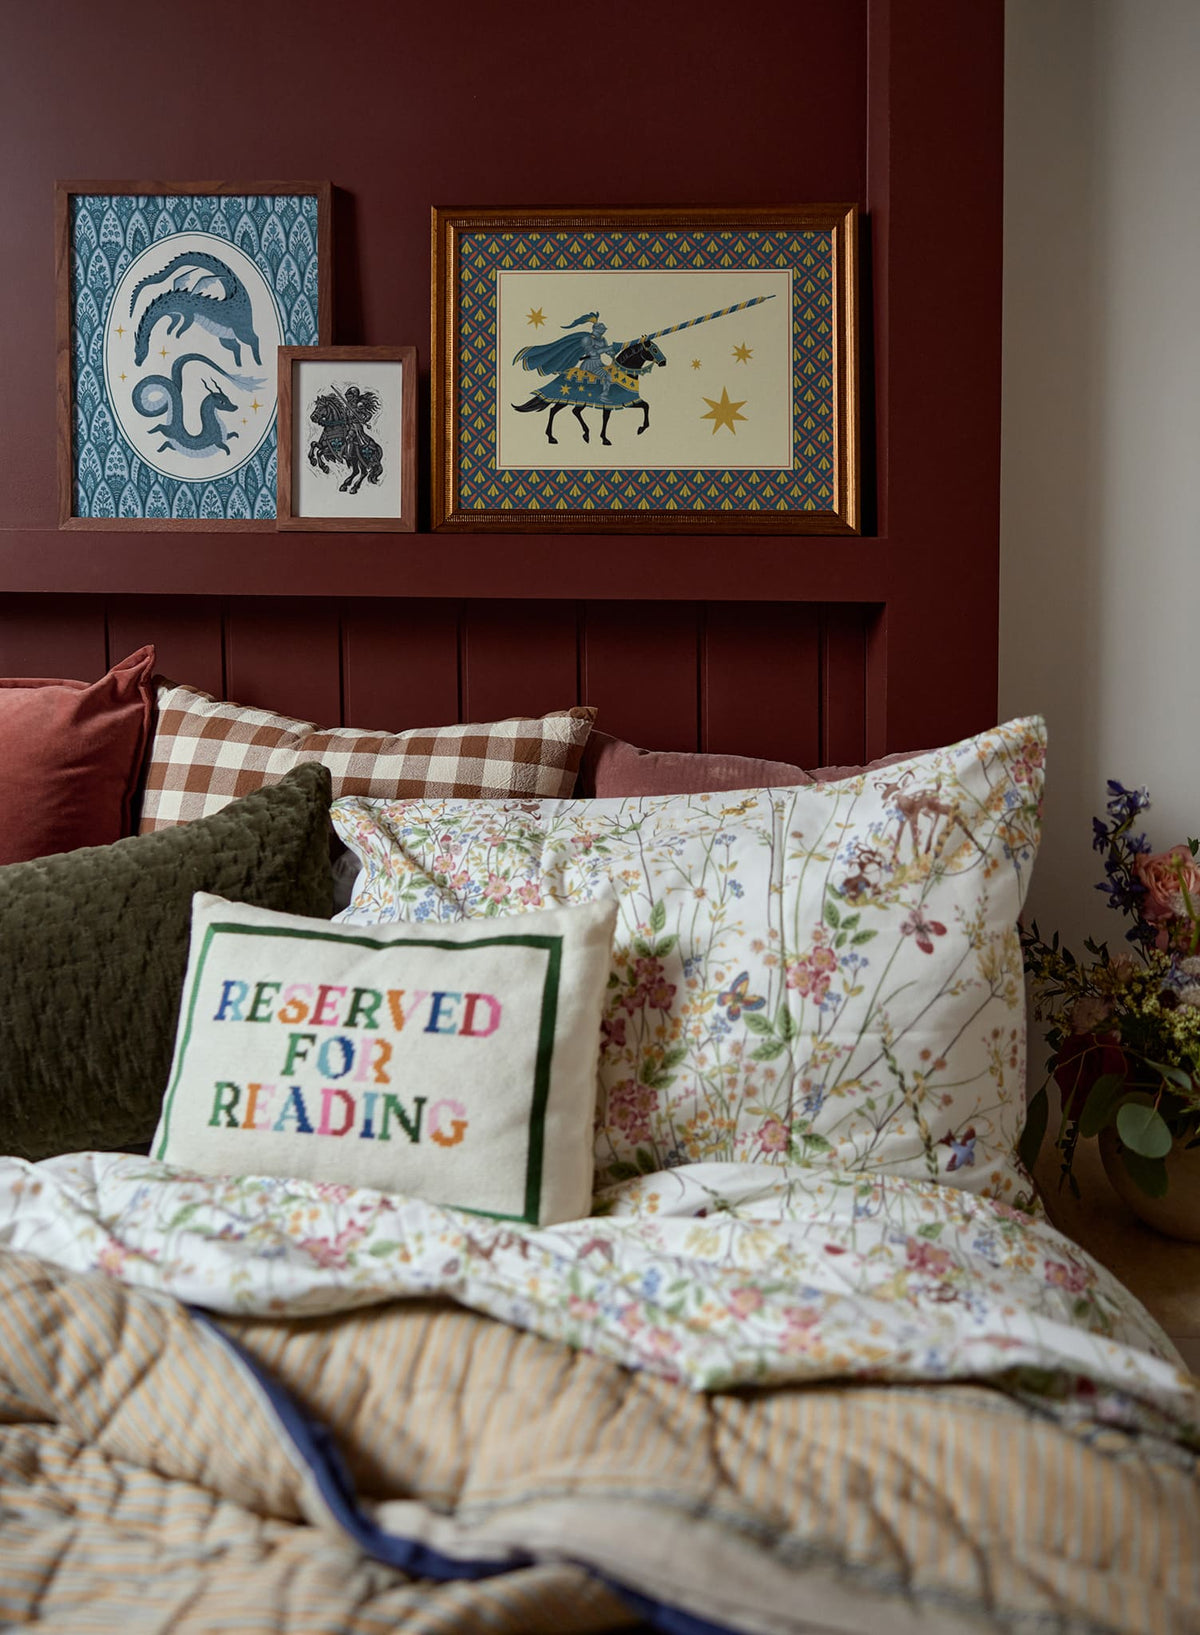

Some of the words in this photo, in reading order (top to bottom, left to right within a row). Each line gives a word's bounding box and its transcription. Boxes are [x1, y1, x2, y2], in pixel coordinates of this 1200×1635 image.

[213, 980, 502, 1038] RESERVED
[280, 1033, 393, 1084] FOR
[207, 1081, 469, 1148] READING
